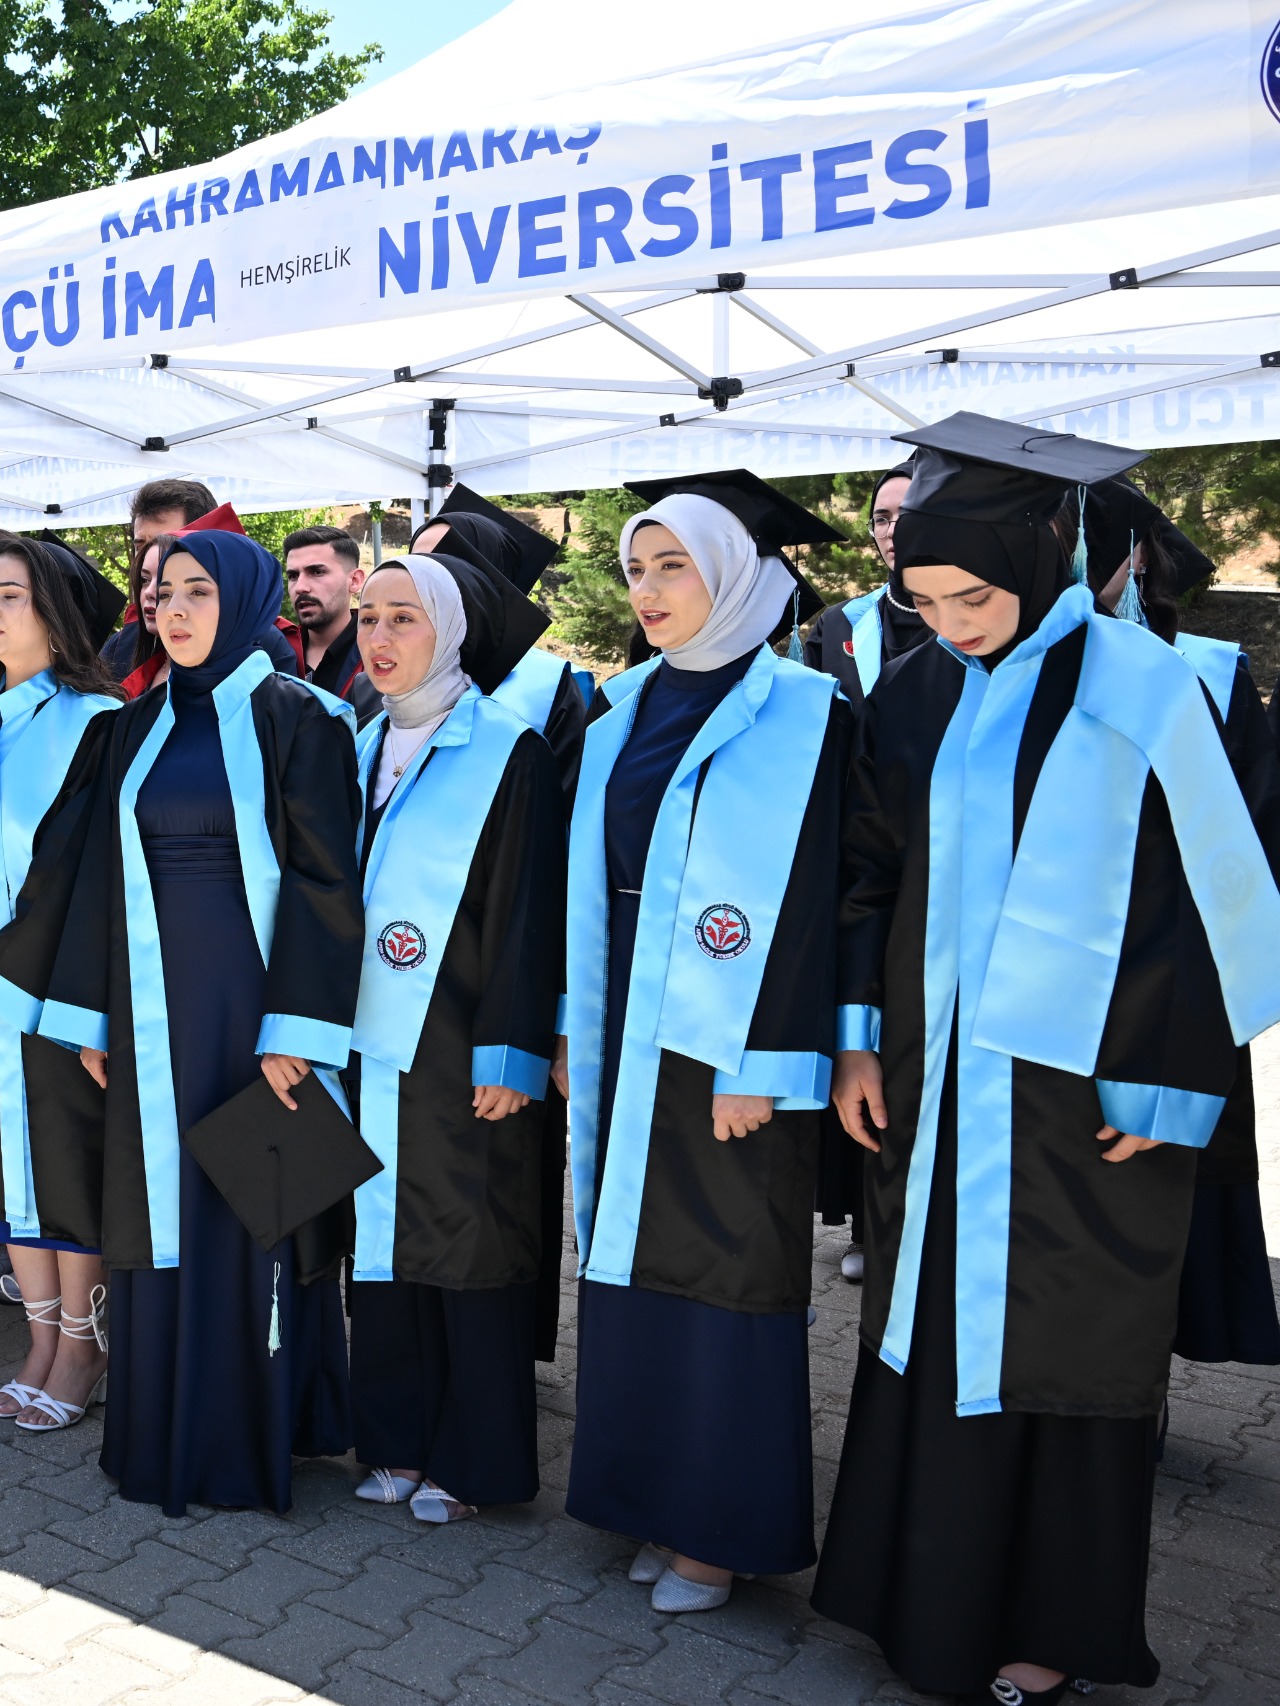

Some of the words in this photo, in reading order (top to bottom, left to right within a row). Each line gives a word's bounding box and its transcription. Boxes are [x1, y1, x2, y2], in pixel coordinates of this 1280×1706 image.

[378, 98, 990, 298] NİVERSİTESİ
[102, 256, 216, 340] İMA
[240, 245, 351, 289] HEMŞİRELİK
